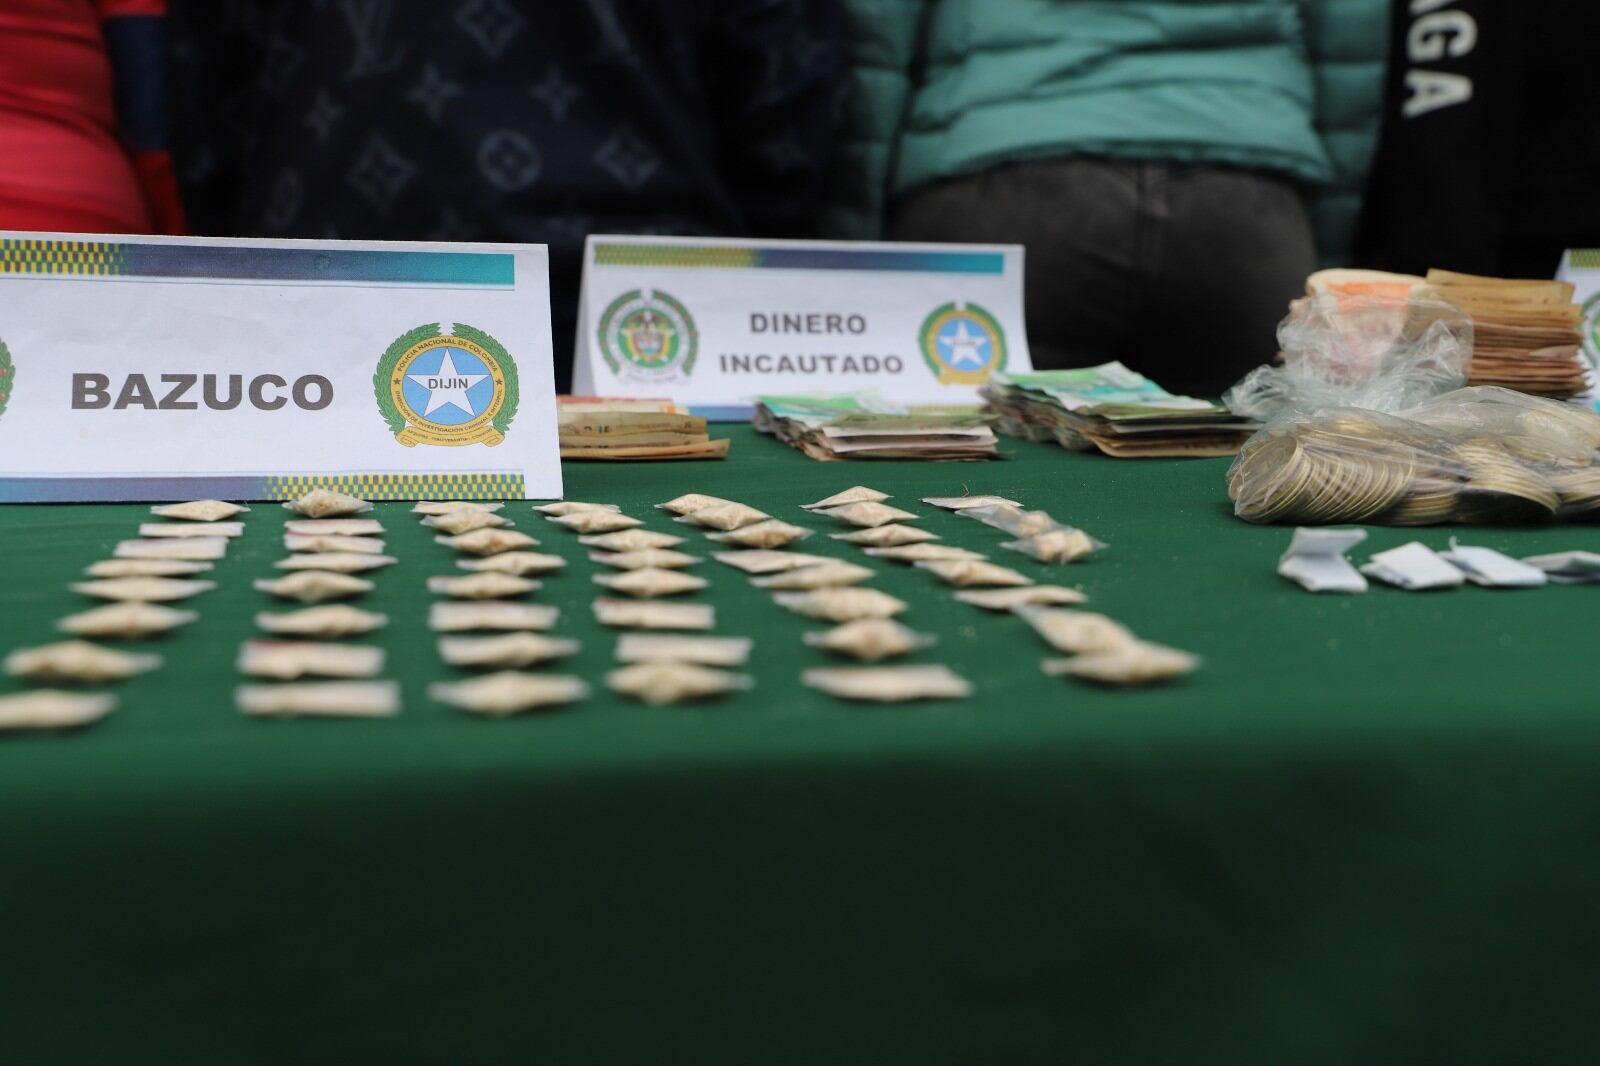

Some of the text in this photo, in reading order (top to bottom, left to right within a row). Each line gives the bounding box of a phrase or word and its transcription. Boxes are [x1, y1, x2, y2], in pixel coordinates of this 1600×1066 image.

[750, 313, 866, 335] DINERO
[418, 338, 456, 350] NACIONAL
[457, 339, 469, 348] DE
[468, 344, 498, 372] COLOMBIA
[720, 353, 904, 375] INCAUTADO
[71, 372, 334, 411] BAZUCO
[428, 378, 468, 389] DIJIN
